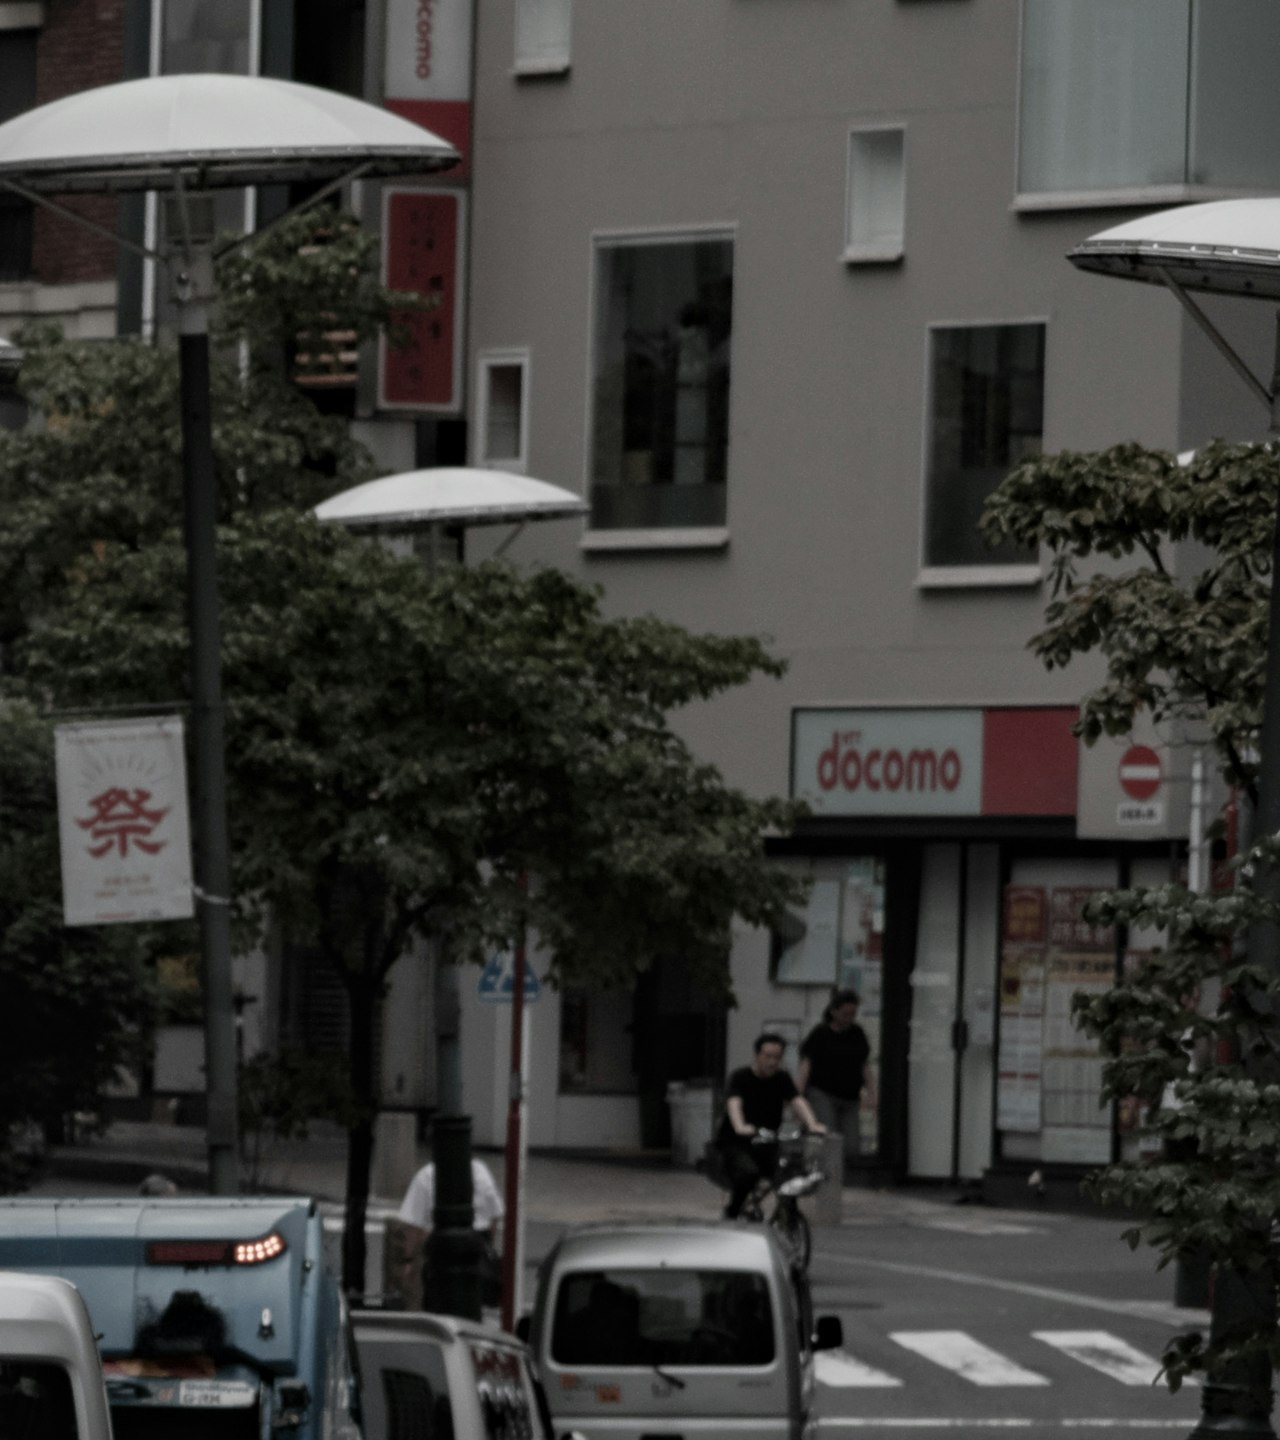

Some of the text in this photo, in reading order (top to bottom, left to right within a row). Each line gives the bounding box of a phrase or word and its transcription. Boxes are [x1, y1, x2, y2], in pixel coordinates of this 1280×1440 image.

[416, 0, 432, 80] como
[818, 732, 961, 791] docomo
[76, 786, 172, 858] 祭
